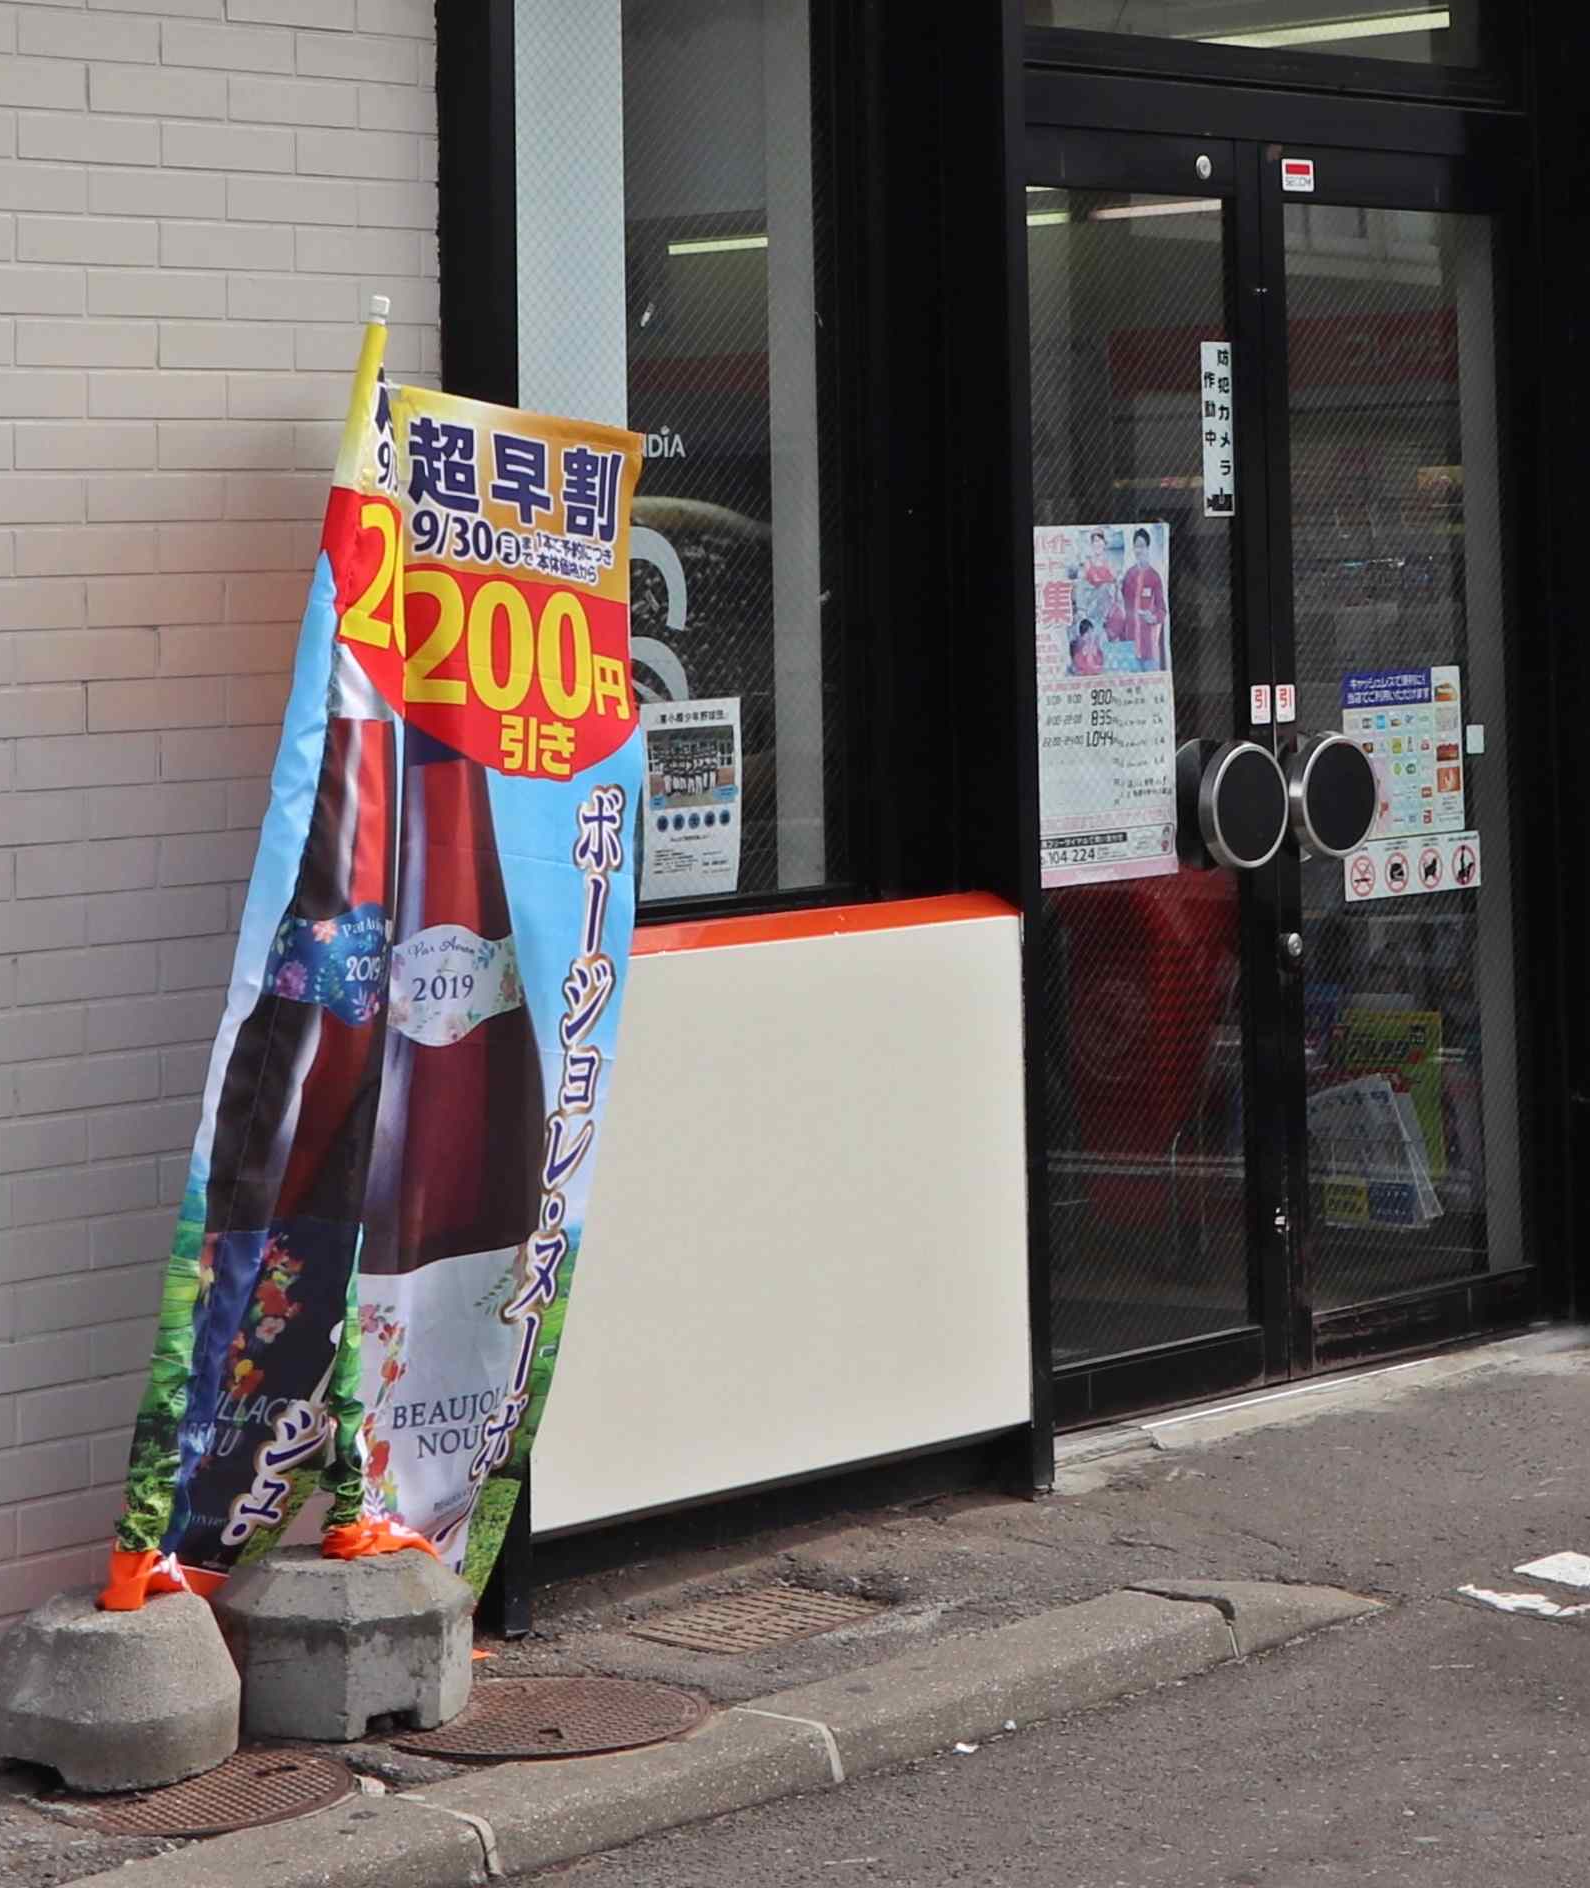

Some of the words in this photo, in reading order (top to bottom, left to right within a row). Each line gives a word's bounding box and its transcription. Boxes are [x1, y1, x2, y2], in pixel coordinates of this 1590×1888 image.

[1203, 370, 1217, 447] 作動中
[1216, 348, 1231, 476] 防犯カメラ
[408, 416, 623, 543] 超早割
[403, 569, 631, 721] 200円
[1255, 688, 1267, 709] 引
[1279, 687, 1292, 709] 引
[500, 714, 576, 776] 引き
[412, 974, 475, 1002] 2019
[392, 1384, 509, 1430] BEAUJOL
[417, 1428, 483, 1459] NOU
